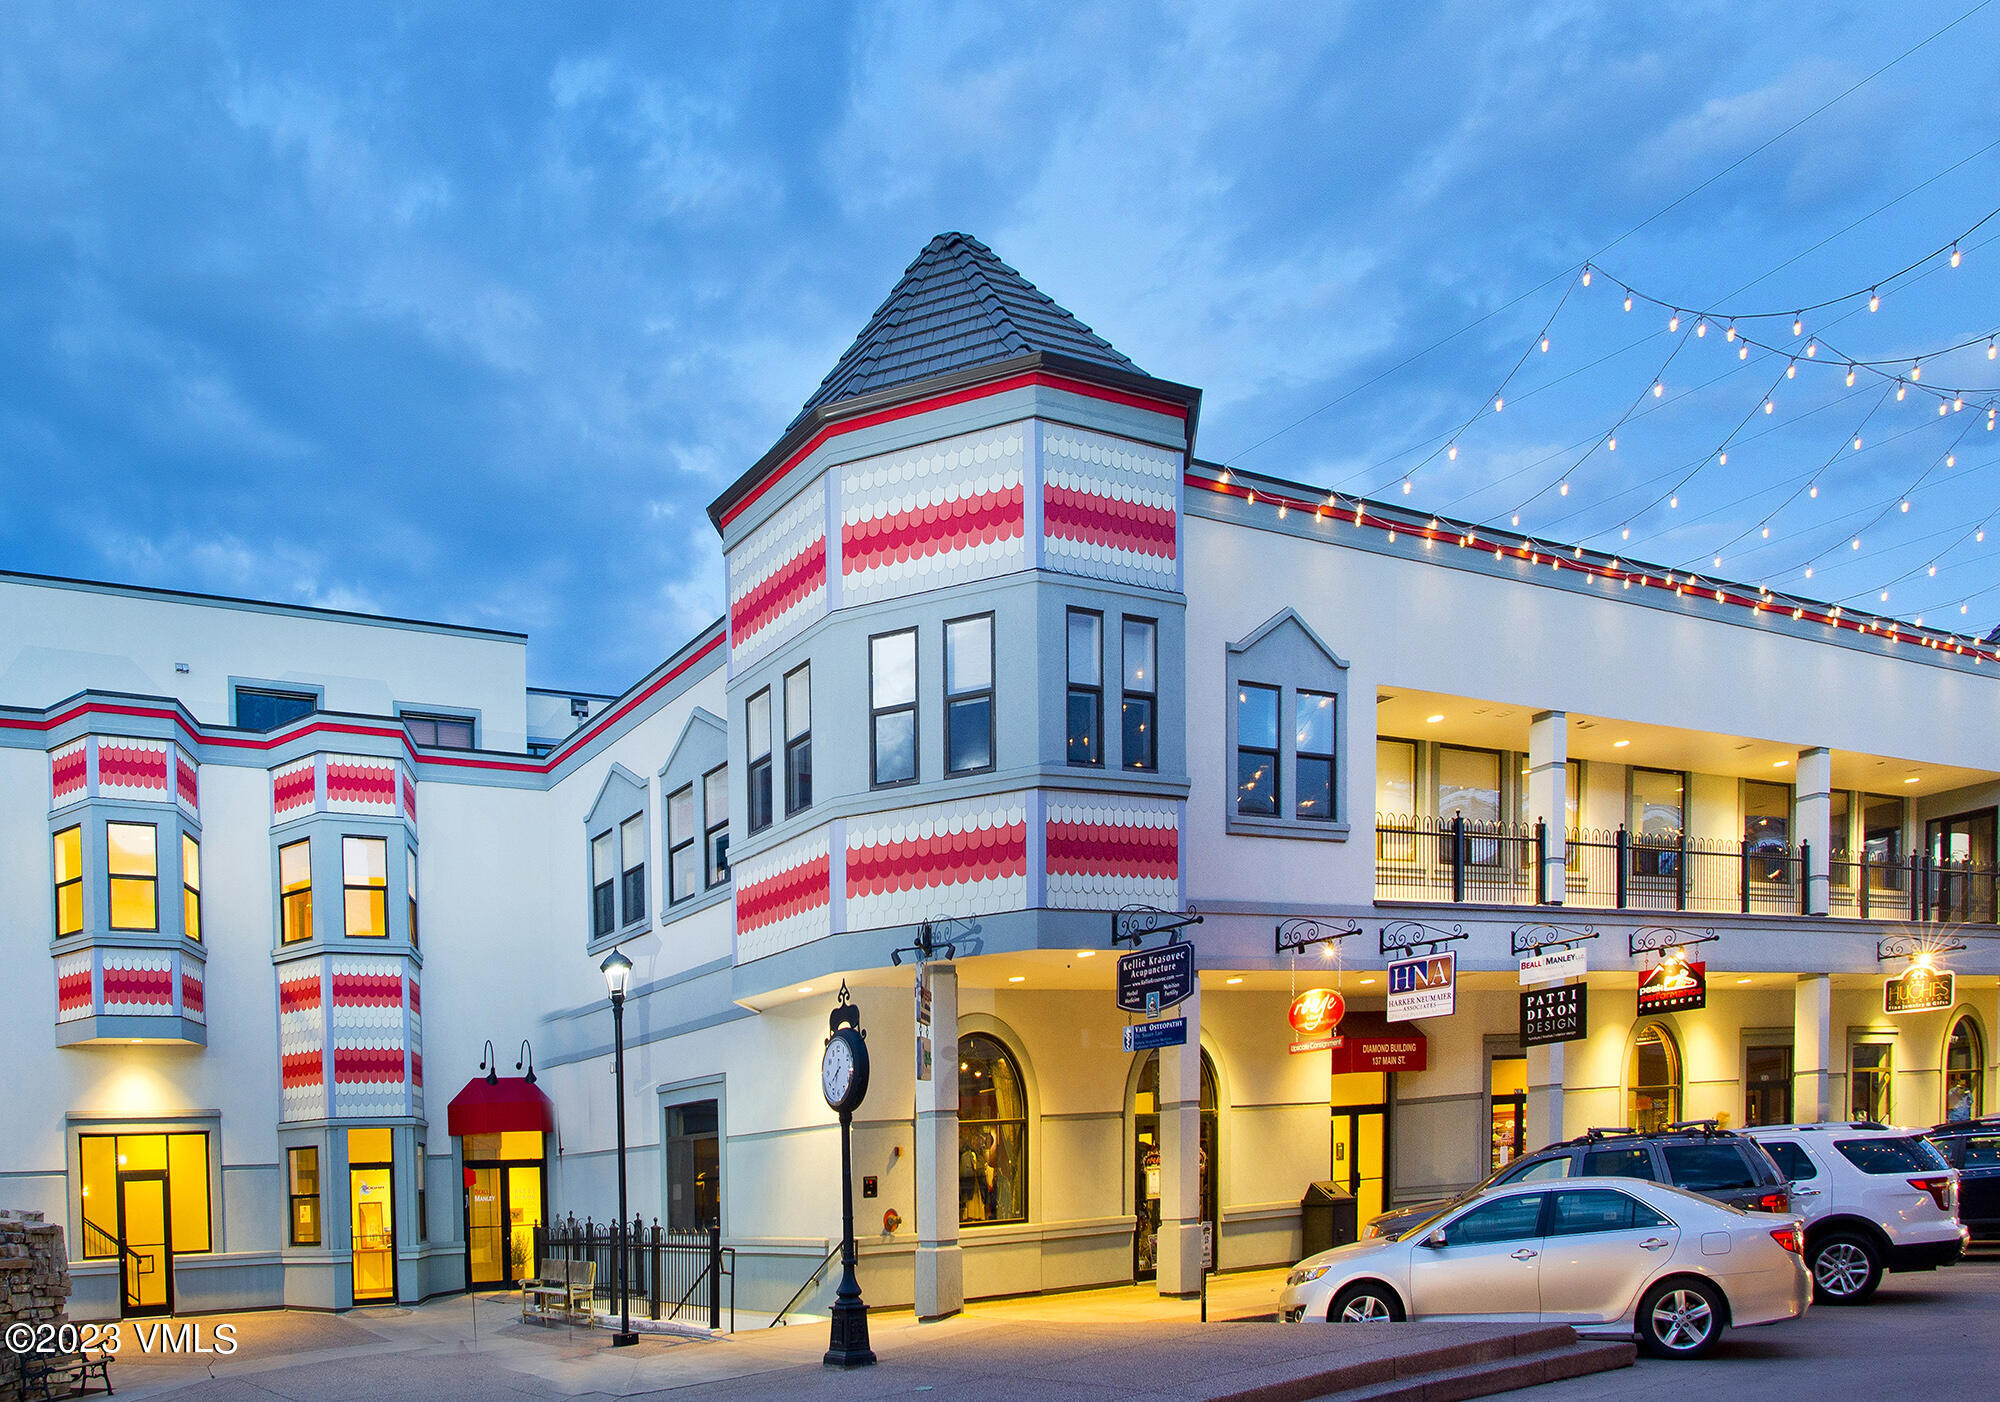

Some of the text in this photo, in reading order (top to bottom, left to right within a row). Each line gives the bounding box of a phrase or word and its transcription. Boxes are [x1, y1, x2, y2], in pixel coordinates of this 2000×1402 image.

[1123, 951, 1185, 971] Kellie Krasovec
[1521, 961, 1541, 970] BEALL
[1545, 953, 1575, 965] MANLEY
[1131, 963, 1176, 978] Acupuncture
[1393, 960, 1448, 991] HNA
[1639, 983, 1664, 995] peak
[1640, 988, 1703, 1003] performance
[1389, 997, 1415, 1008] HARKER
[1527, 989, 1576, 1007] PATTI
[1403, 1002, 1437, 1011] ASSOCIATES
[1527, 1003, 1576, 1020] DIXON
[1149, 1020, 1183, 1031] OSTEOPATHY
[1527, 1017, 1576, 1034] DESIGN
[1362, 1043, 1416, 1053] DIAMOND BUILDING
[1372, 1056, 1406, 1065] 137 MAIN ST.
